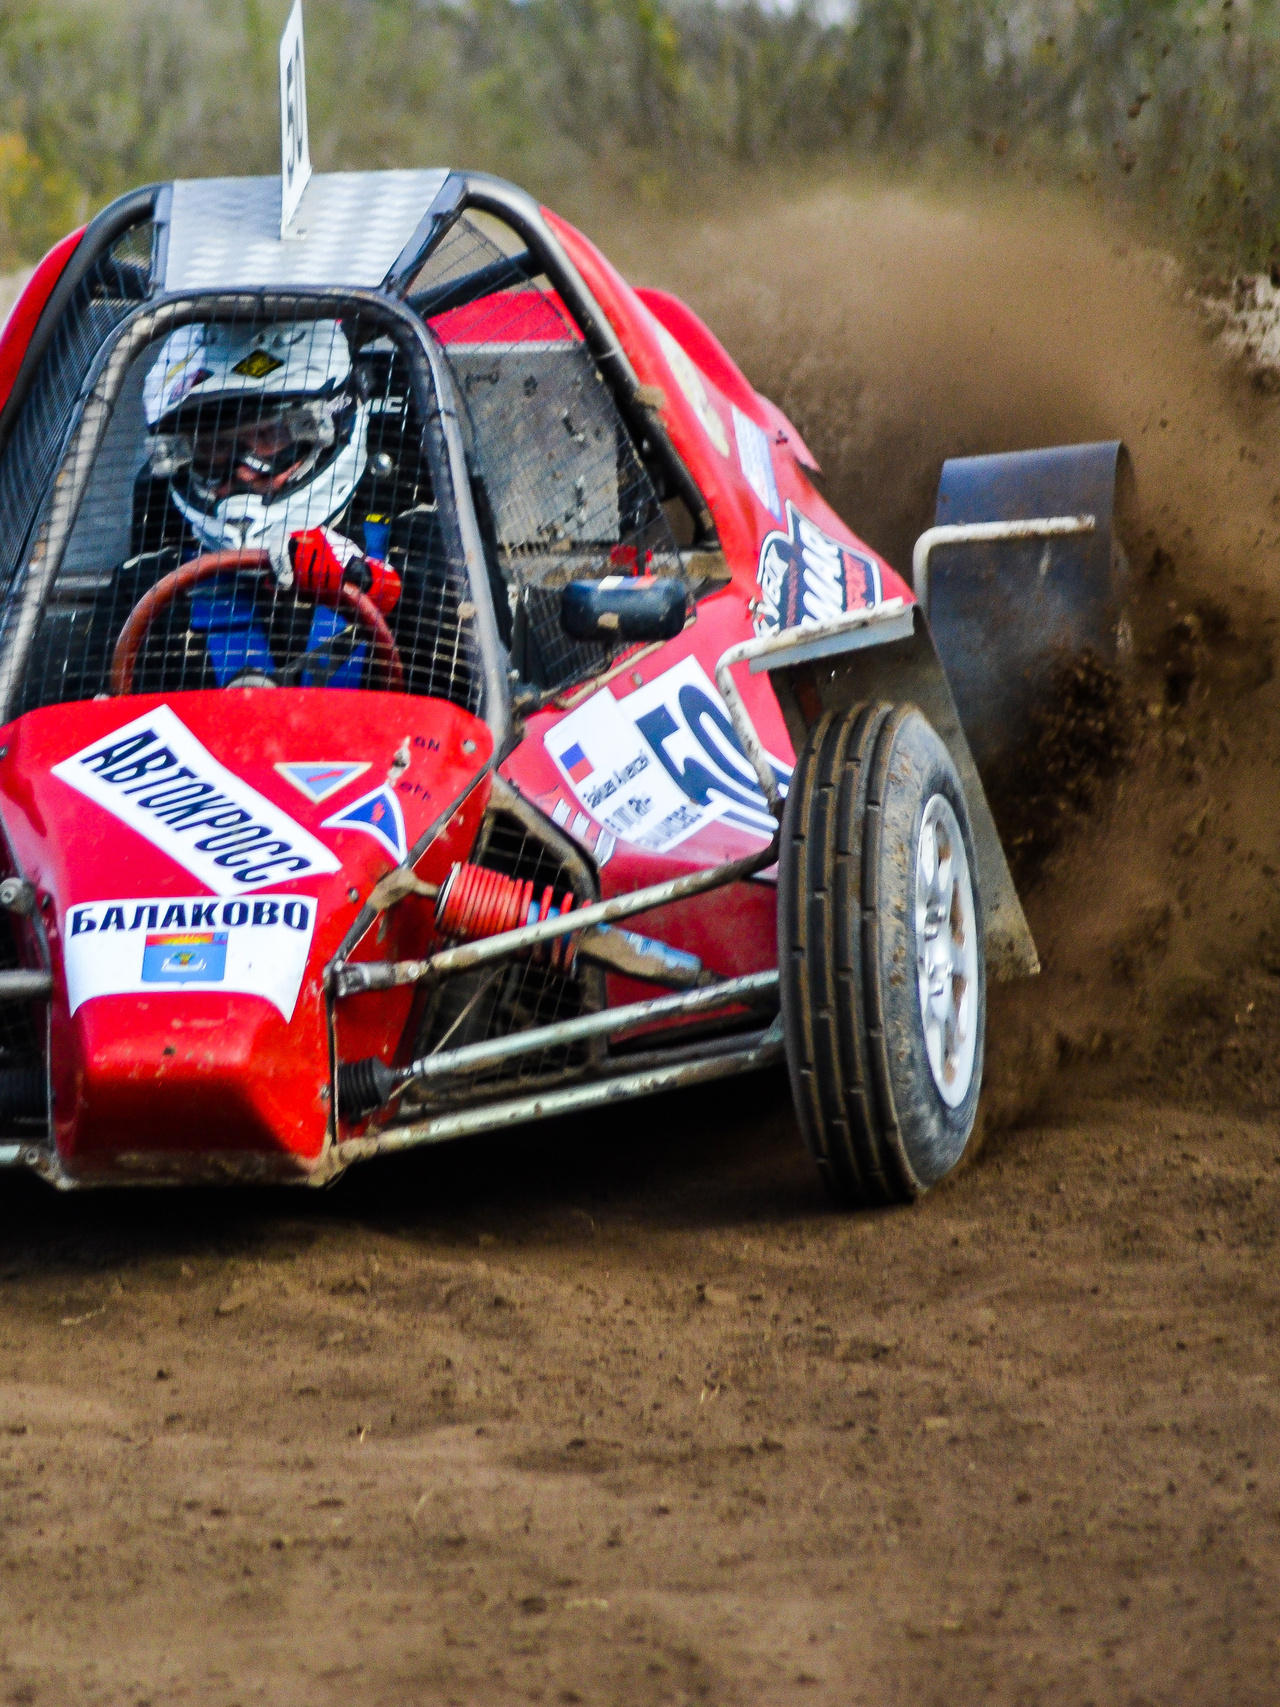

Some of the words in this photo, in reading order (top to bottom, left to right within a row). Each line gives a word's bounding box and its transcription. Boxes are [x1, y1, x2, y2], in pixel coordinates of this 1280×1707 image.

[80, 727, 312, 883] АВТОКРОСС
[634, 684, 794, 836] 50
[71, 901, 311, 938] БАЛАКОВО
